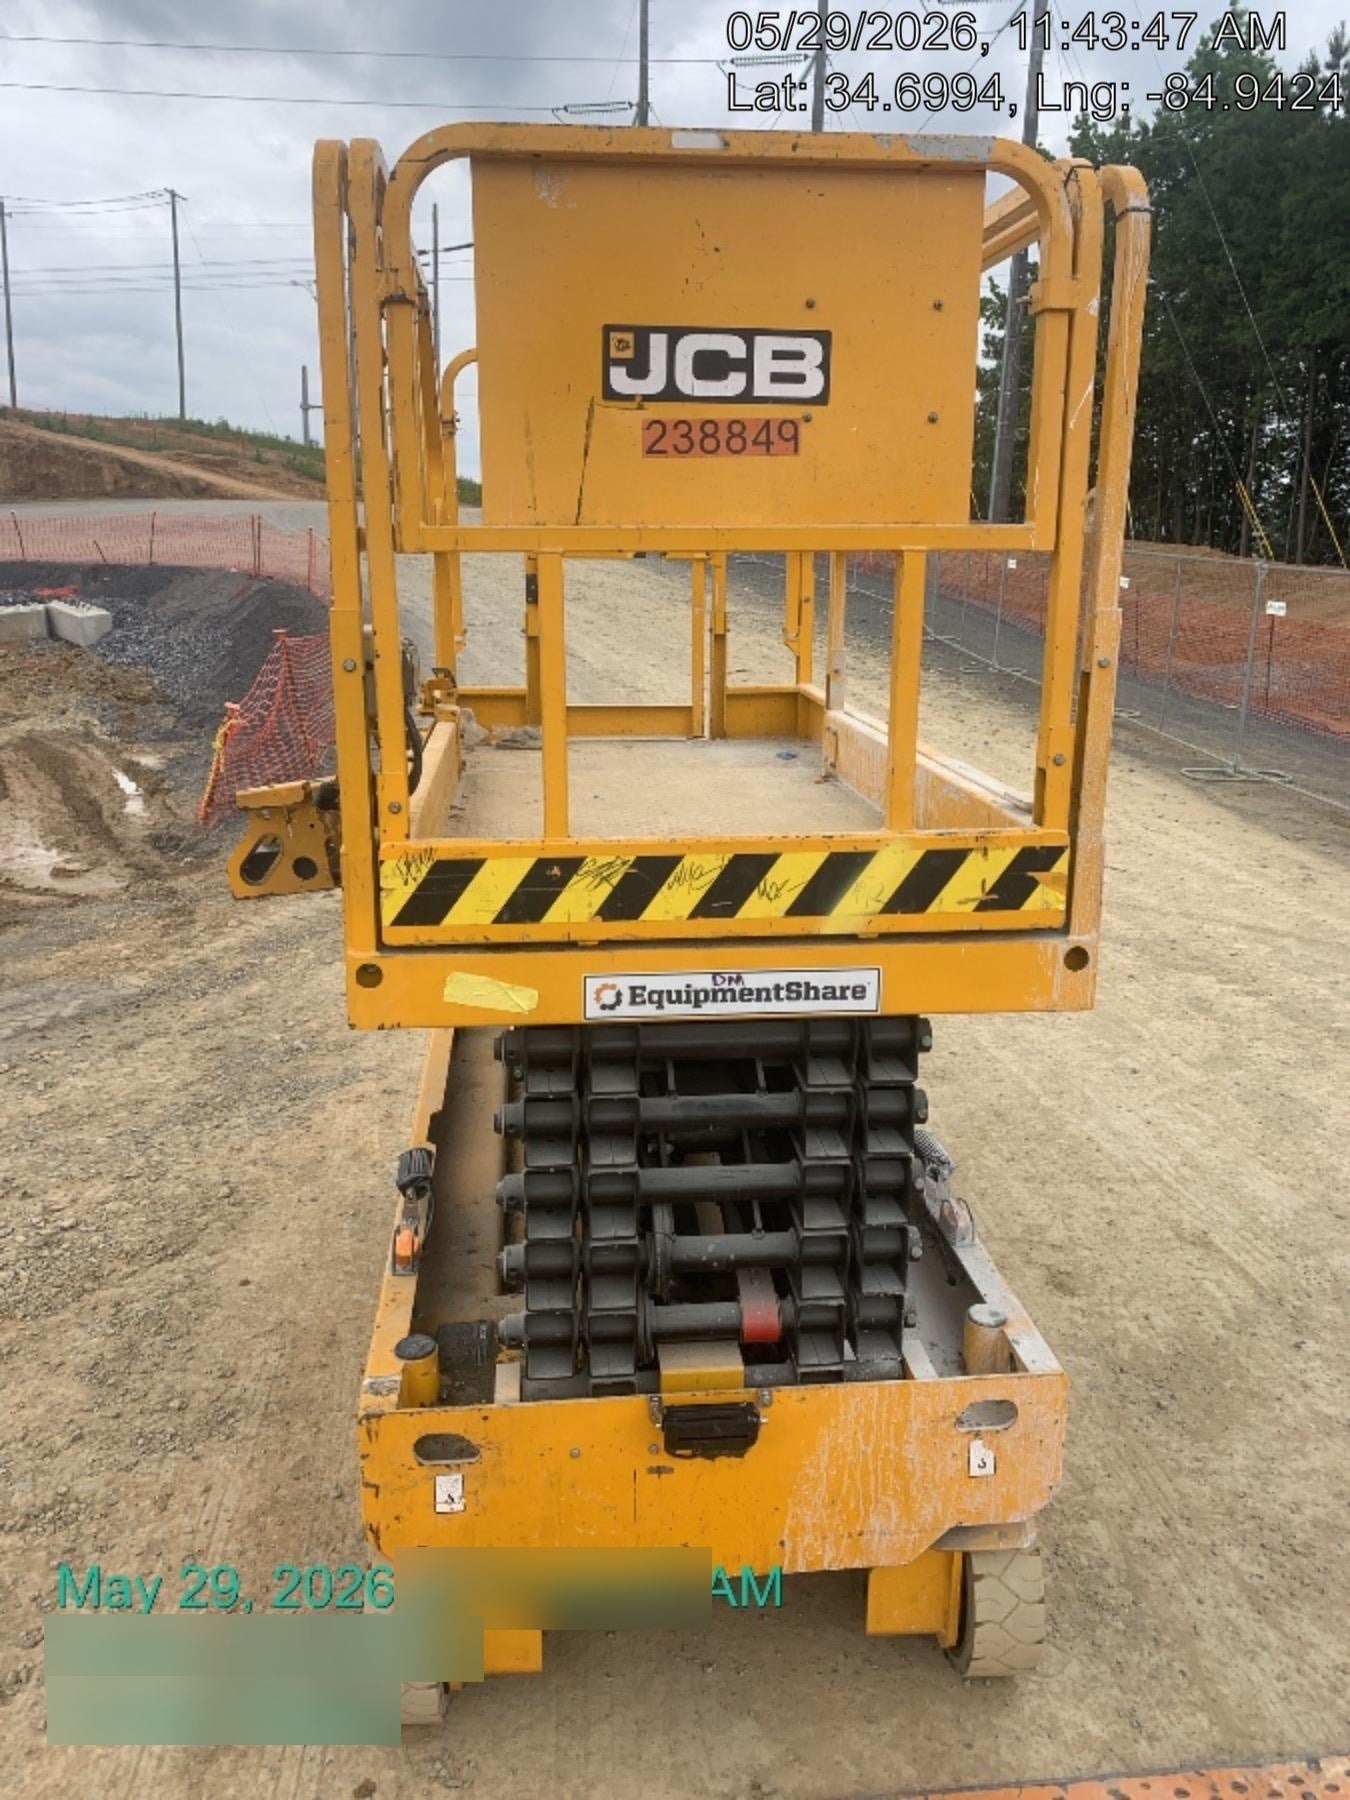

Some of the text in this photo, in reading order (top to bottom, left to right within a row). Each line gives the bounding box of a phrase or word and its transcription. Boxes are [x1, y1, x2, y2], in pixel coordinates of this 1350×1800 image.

[609, 332, 826, 399] JCB
[644, 419, 800, 456] 238849
[628, 981, 867, 1009] EquipmentShare
